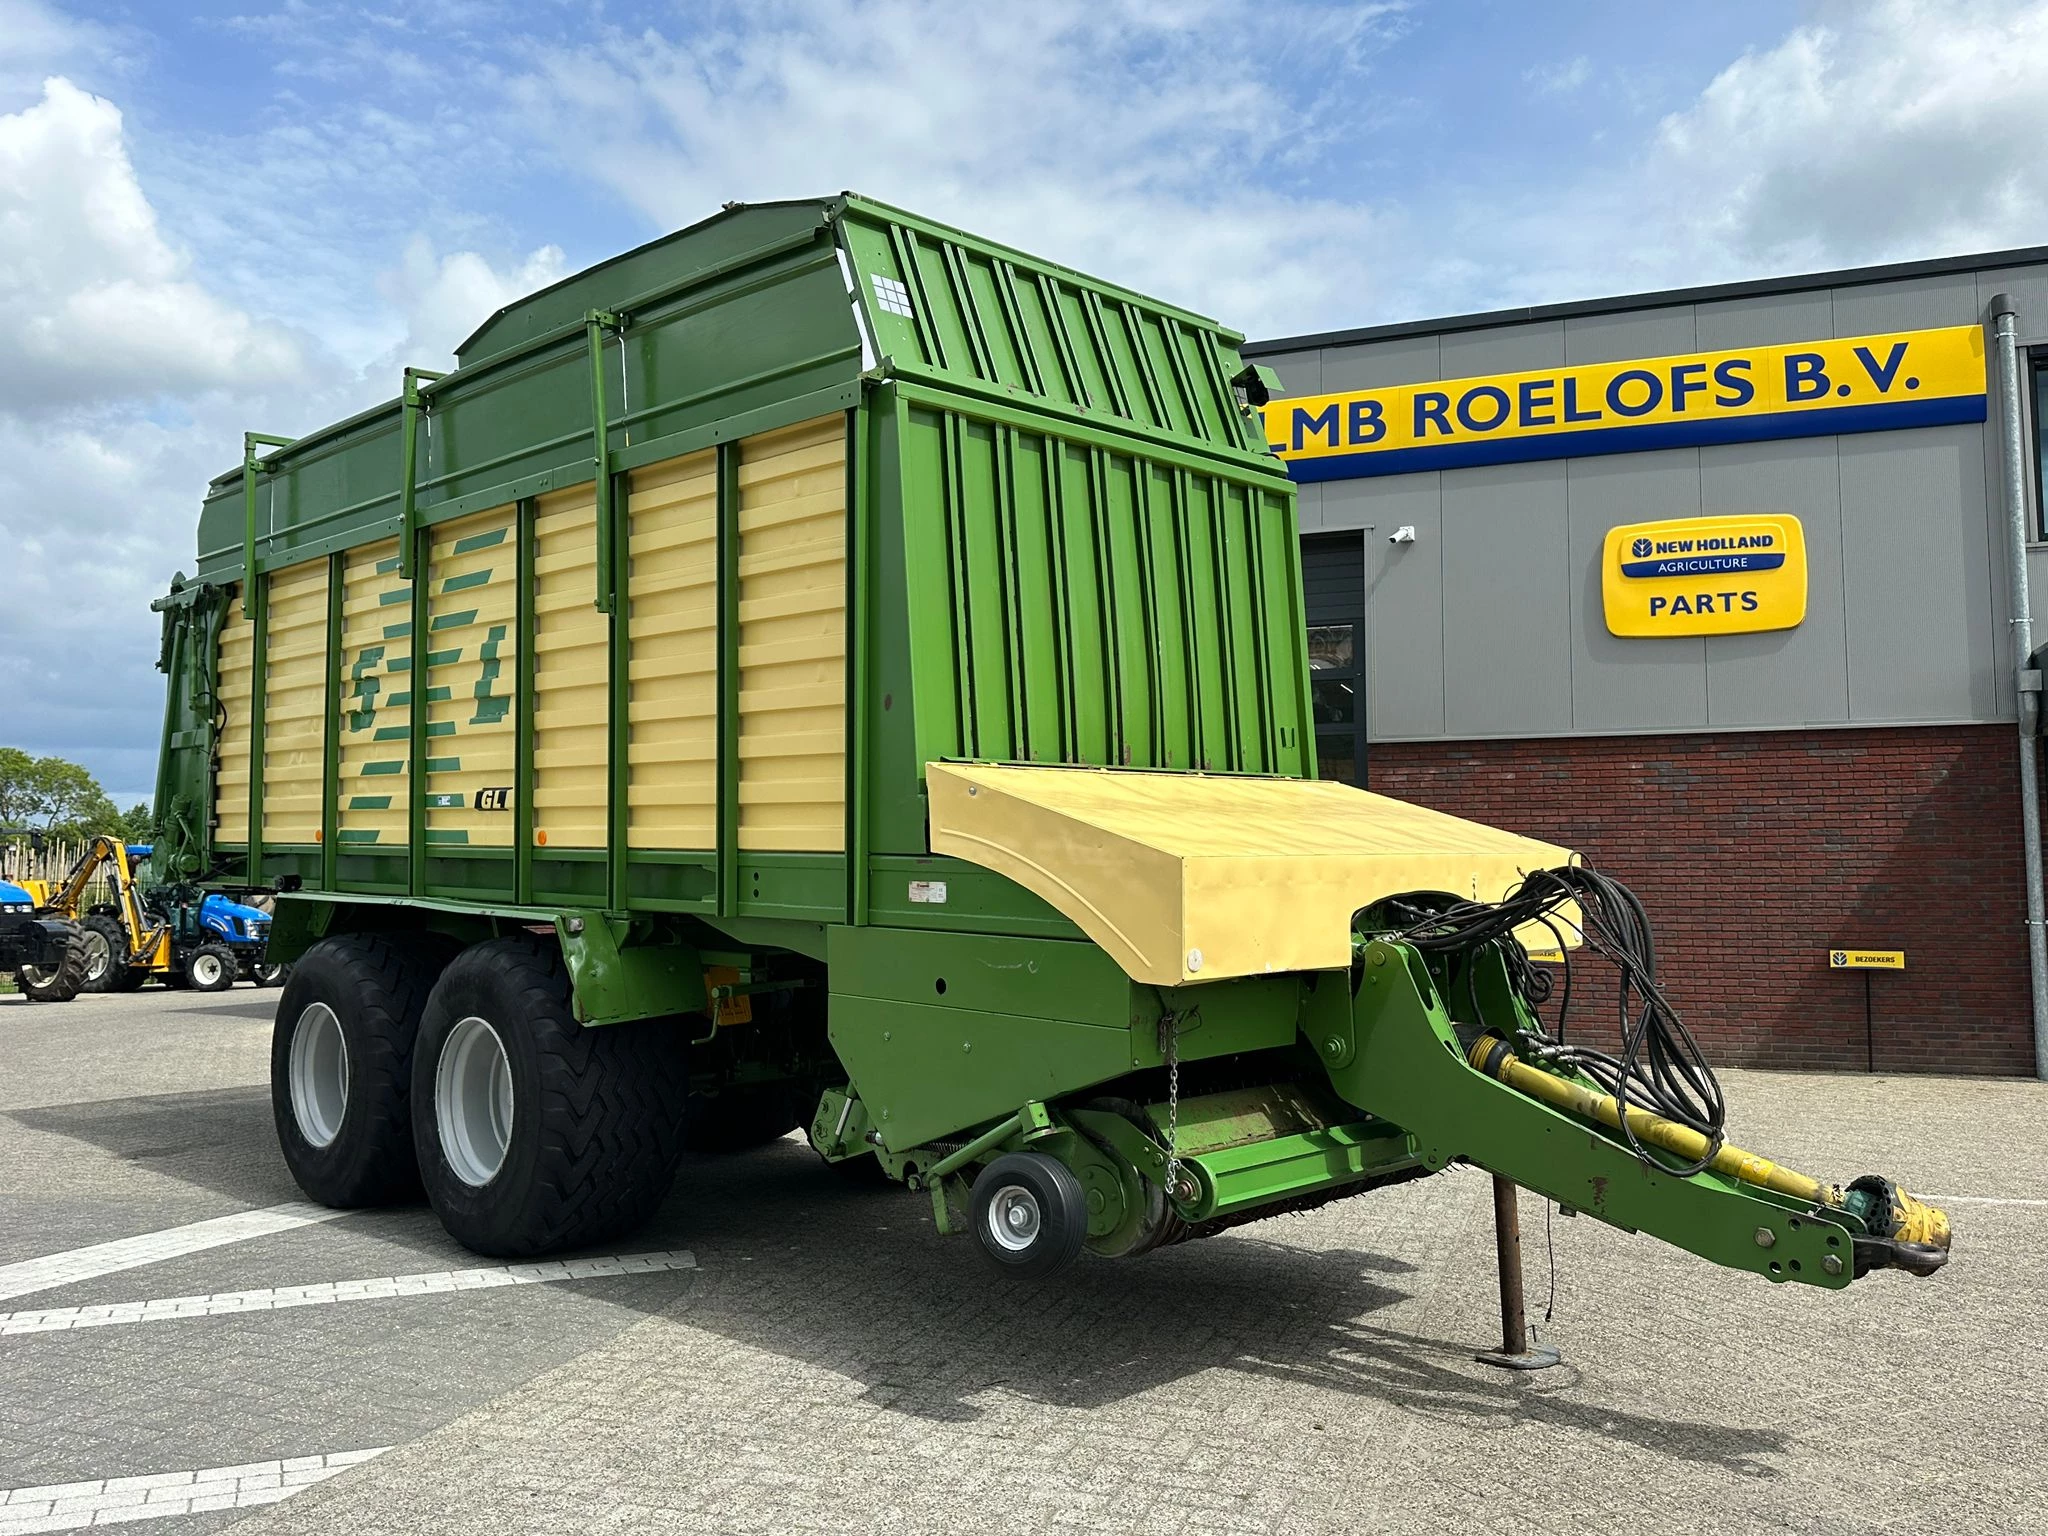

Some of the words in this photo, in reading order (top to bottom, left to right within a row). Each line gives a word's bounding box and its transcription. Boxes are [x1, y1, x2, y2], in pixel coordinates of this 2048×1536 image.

[1413, 359, 1755, 437] ROELOFS
[1784, 342, 1920, 402] B.V.
[1656, 539, 1693, 554] NEW
[1697, 535, 1773, 551] HOLLAND
[1658, 557, 1748, 573] AGRICULTURE
[1650, 591, 1758, 617] PARTS
[1855, 955, 1895, 963] BEZOEKERS
